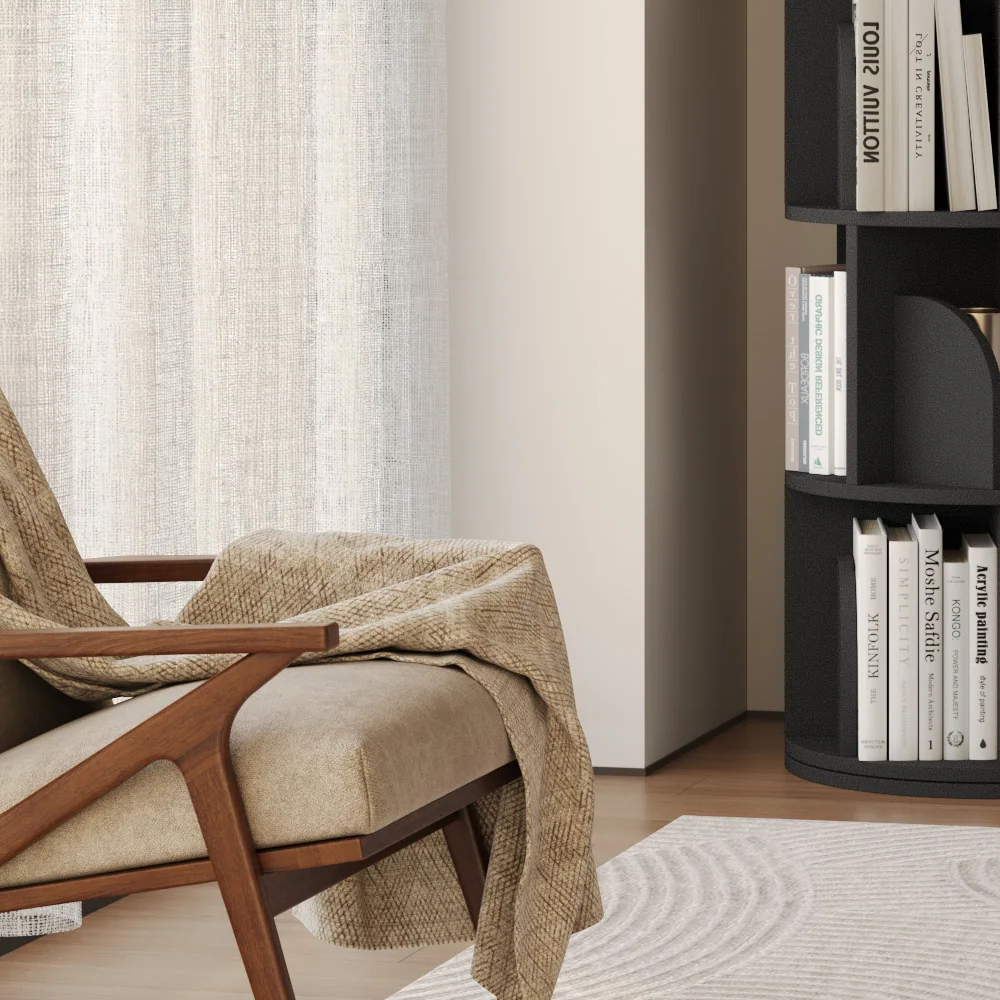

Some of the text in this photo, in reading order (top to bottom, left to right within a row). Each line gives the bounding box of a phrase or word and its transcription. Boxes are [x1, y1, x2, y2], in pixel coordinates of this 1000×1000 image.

[867, 613, 879, 679] KINFOLK
[898, 557, 909, 666] SIMPLICITY
[924, 549, 940, 663] Moshe Safdie
[951, 599, 961, 641] KONGO:
[976, 565, 989, 665] Acrylic painting
[978, 675, 987, 723] style of painting
